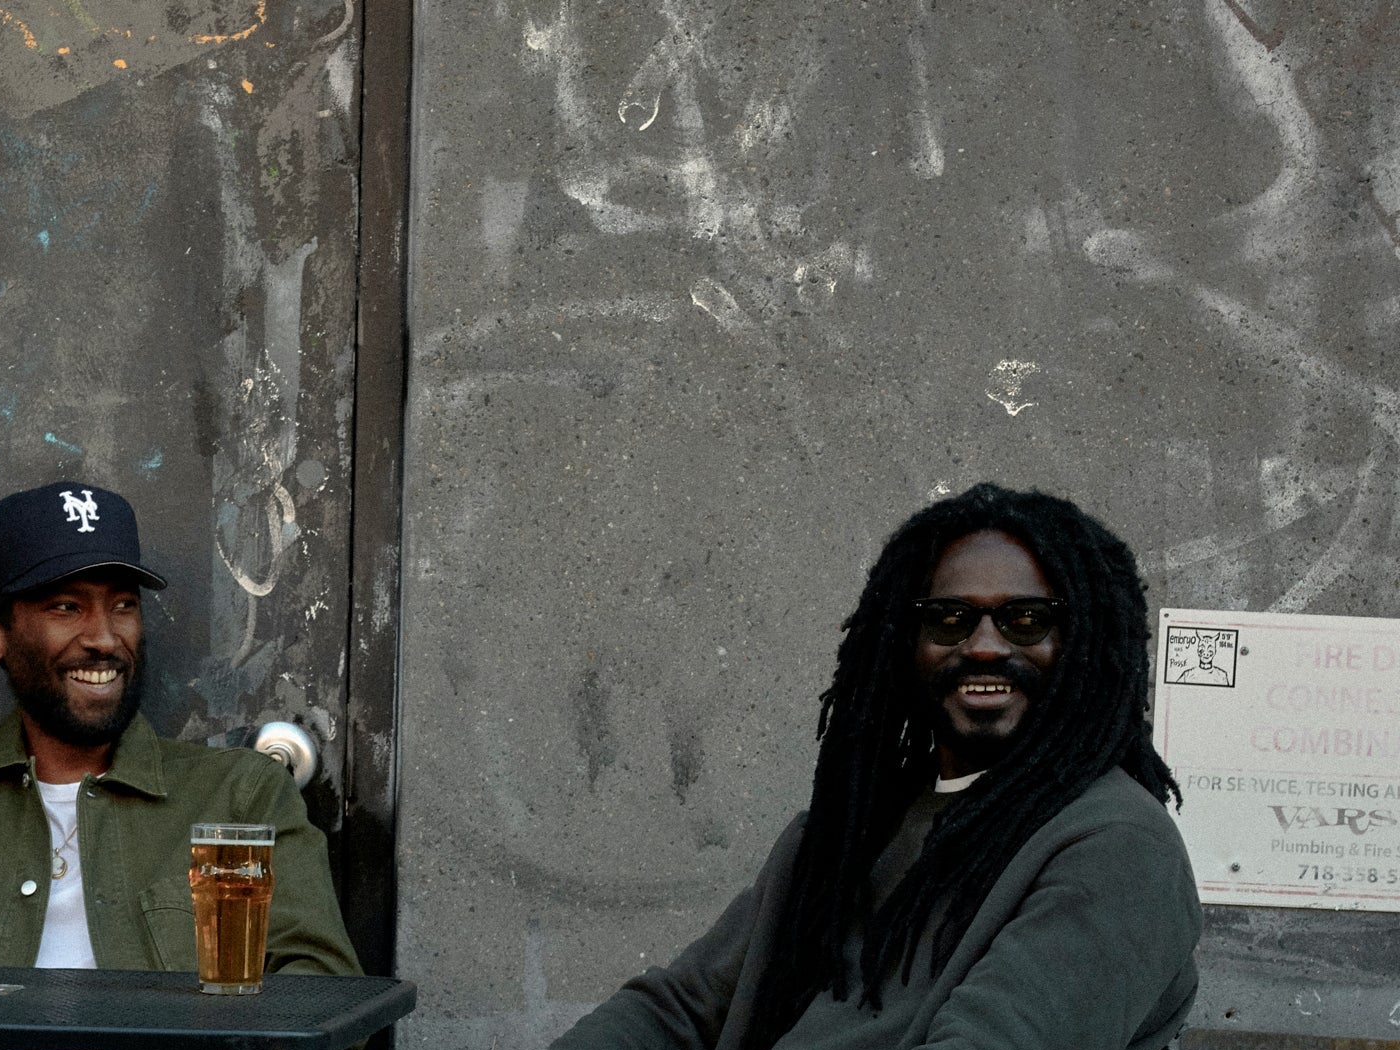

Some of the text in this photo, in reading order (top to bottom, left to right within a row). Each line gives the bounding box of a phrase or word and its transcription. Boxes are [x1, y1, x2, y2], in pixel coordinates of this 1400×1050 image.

[1187, 776, 1222, 792] FOR
[1307, 780, 1379, 799] TESTING
[1271, 839, 1344, 859] Plumbing
[1363, 844, 1392, 858] Fire
